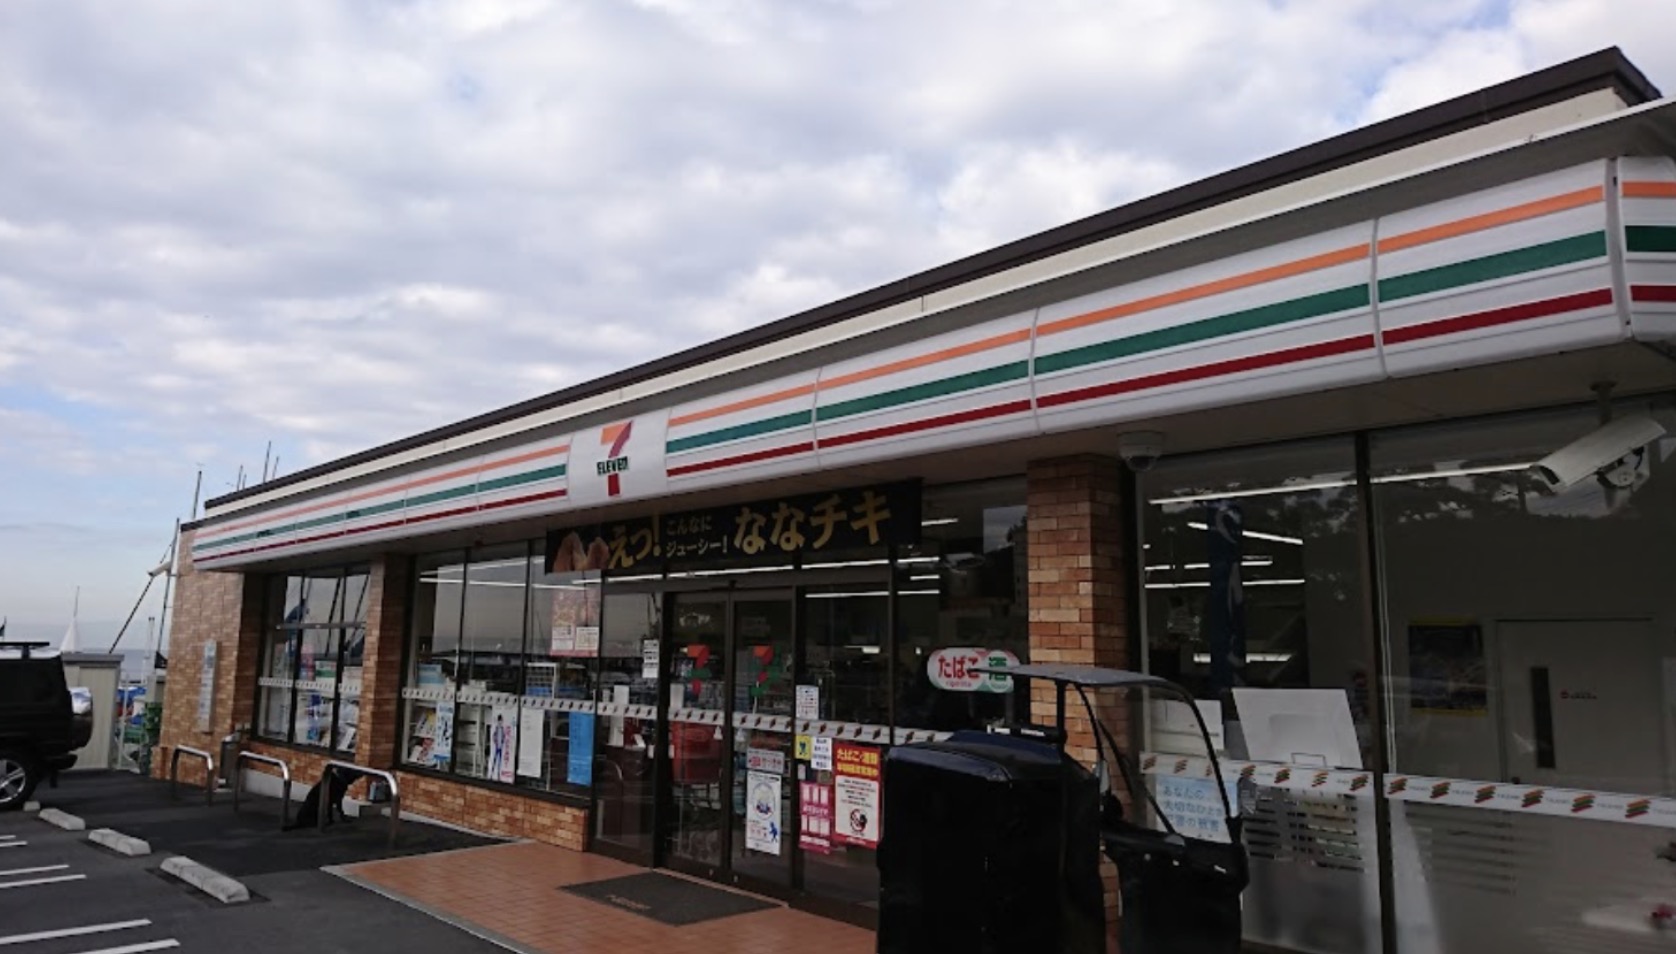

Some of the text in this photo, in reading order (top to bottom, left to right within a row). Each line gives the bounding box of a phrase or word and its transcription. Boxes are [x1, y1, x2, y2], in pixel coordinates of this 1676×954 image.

[666, 516, 712, 536] こんなに
[734, 490, 891, 554] ななチキ
[938, 655, 980, 679] たばこ
